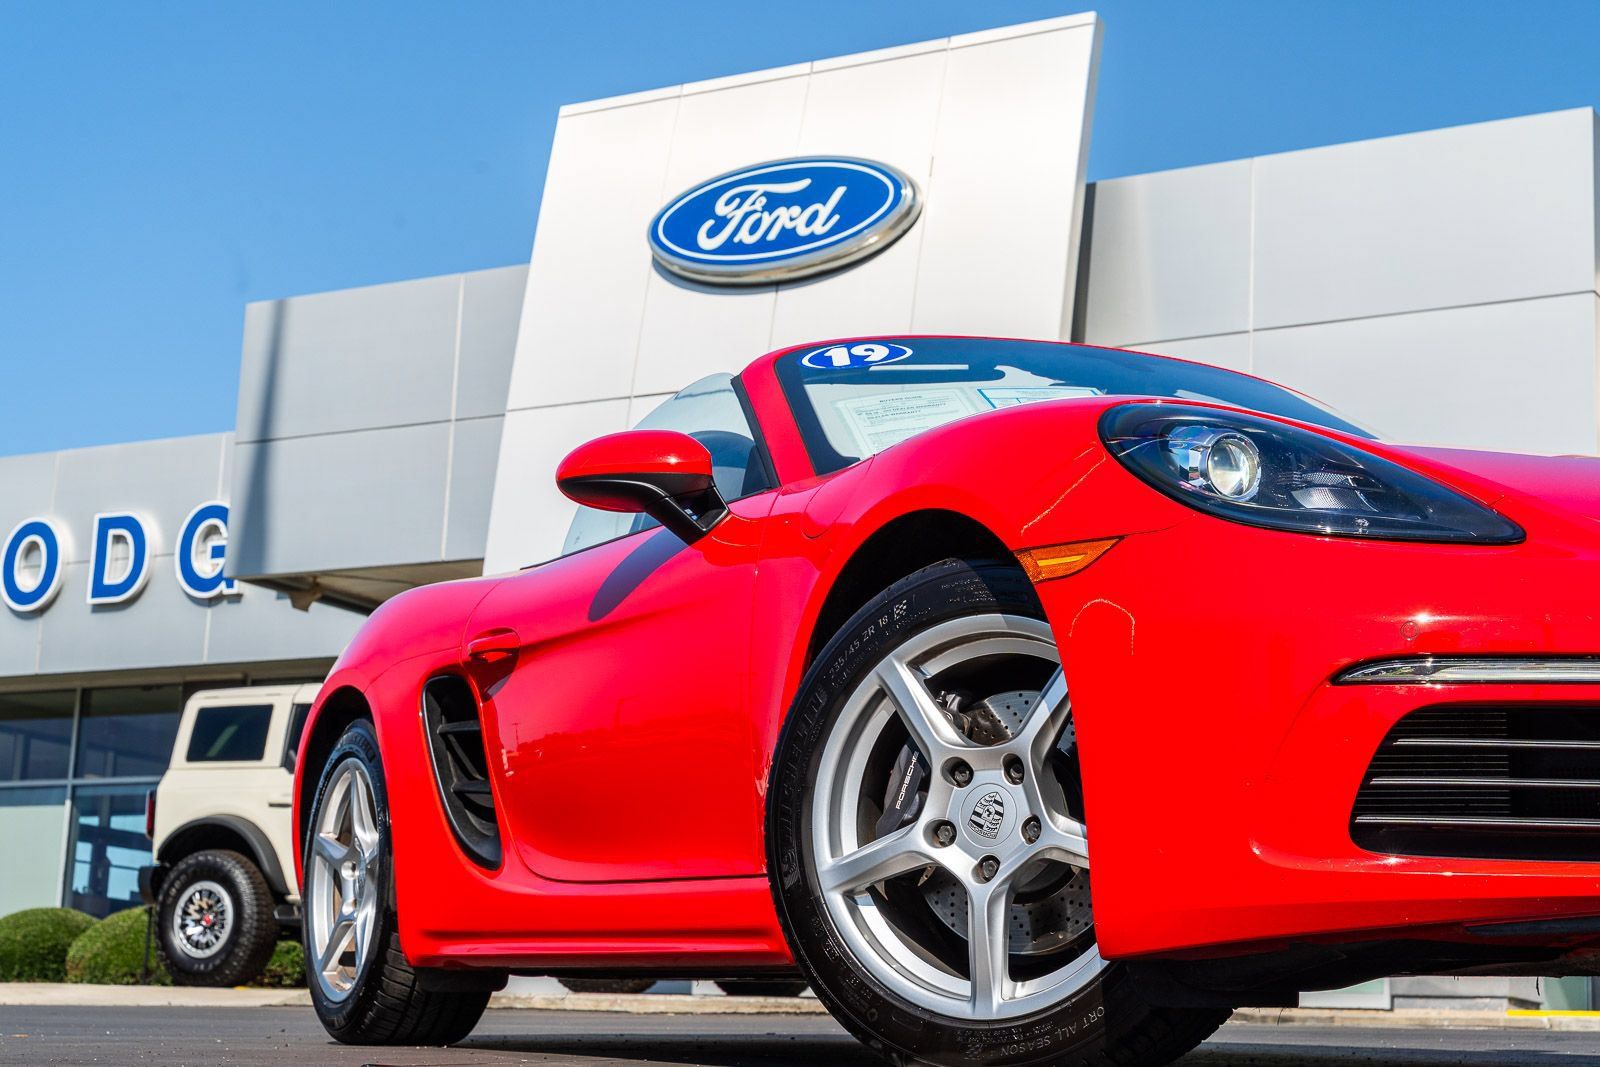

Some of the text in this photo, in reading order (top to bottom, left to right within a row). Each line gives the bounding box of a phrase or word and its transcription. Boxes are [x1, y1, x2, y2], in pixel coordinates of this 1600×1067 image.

[697, 178, 847, 250] Ford
[824, 344, 889, 366] 19
[895, 751, 919, 809] PORSCHE
[1055, 1022, 1077, 1040] ALL
[1000, 1036, 1051, 1056] SEASON
